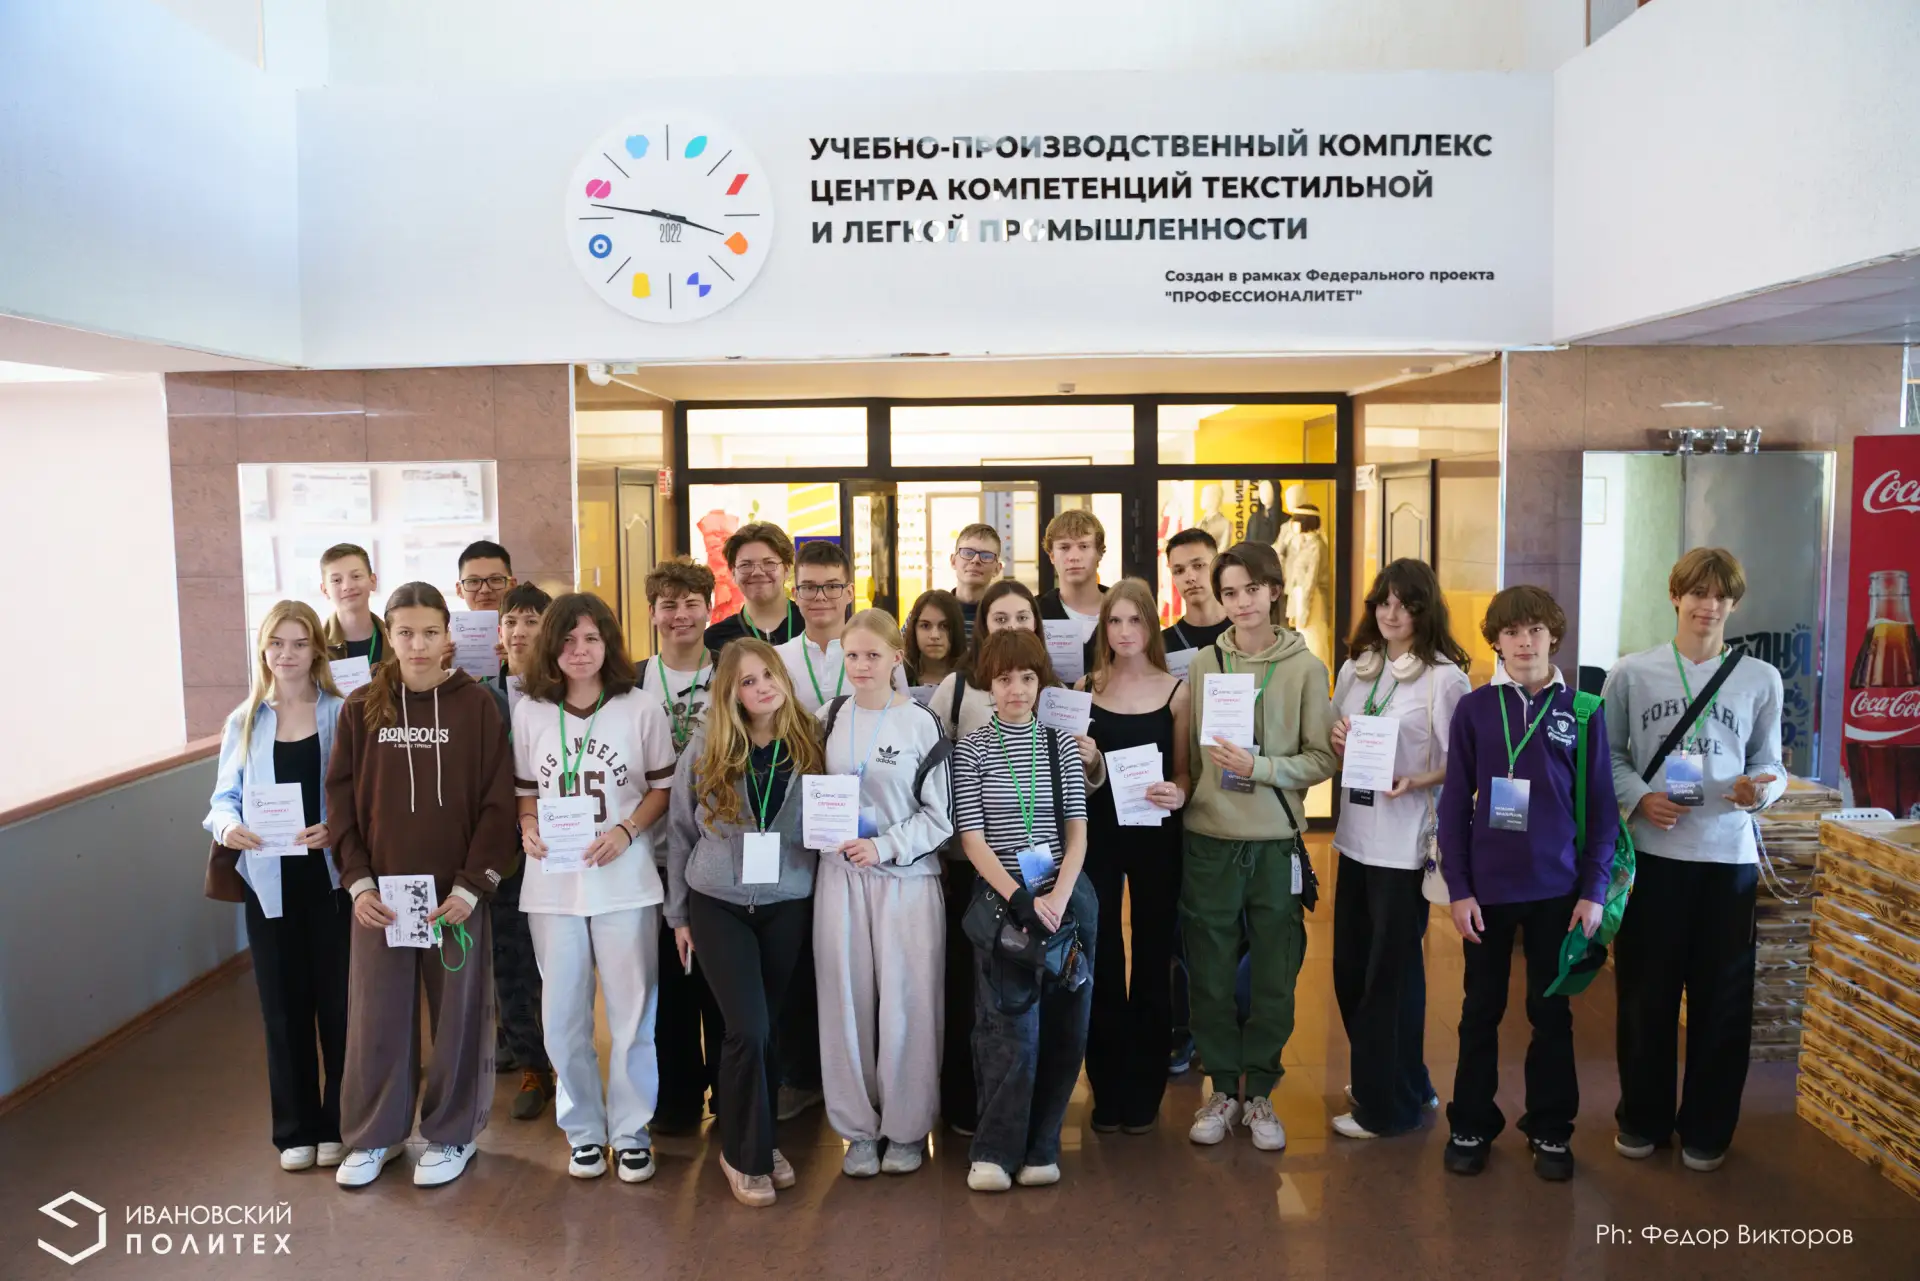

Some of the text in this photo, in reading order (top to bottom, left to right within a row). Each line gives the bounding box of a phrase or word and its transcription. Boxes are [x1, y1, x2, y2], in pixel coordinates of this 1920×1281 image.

[809, 128, 1493, 161] УЧЕБНО-ПРОИЗВОДСТВЕННЫЙ КОМПЛЕКС
[811, 170, 1433, 205] ЦЕНТРА КОМПЕТЕНЦИЙ ТЕКСТИЛЬНОЙ
[659, 223, 682, 242] 2022
[812, 213, 1308, 243] И ЛЕГКОЙ ПРОМЫШЛЕННОСТИ
[1165, 268, 1495, 284] Создан в рамках Федерального проекта
[1165, 289, 1363, 303] "ПРОФЕССИОНАЛИТЕТ"
[378, 727, 449, 743] BONEOUS
[875, 758, 897, 766] adidas
